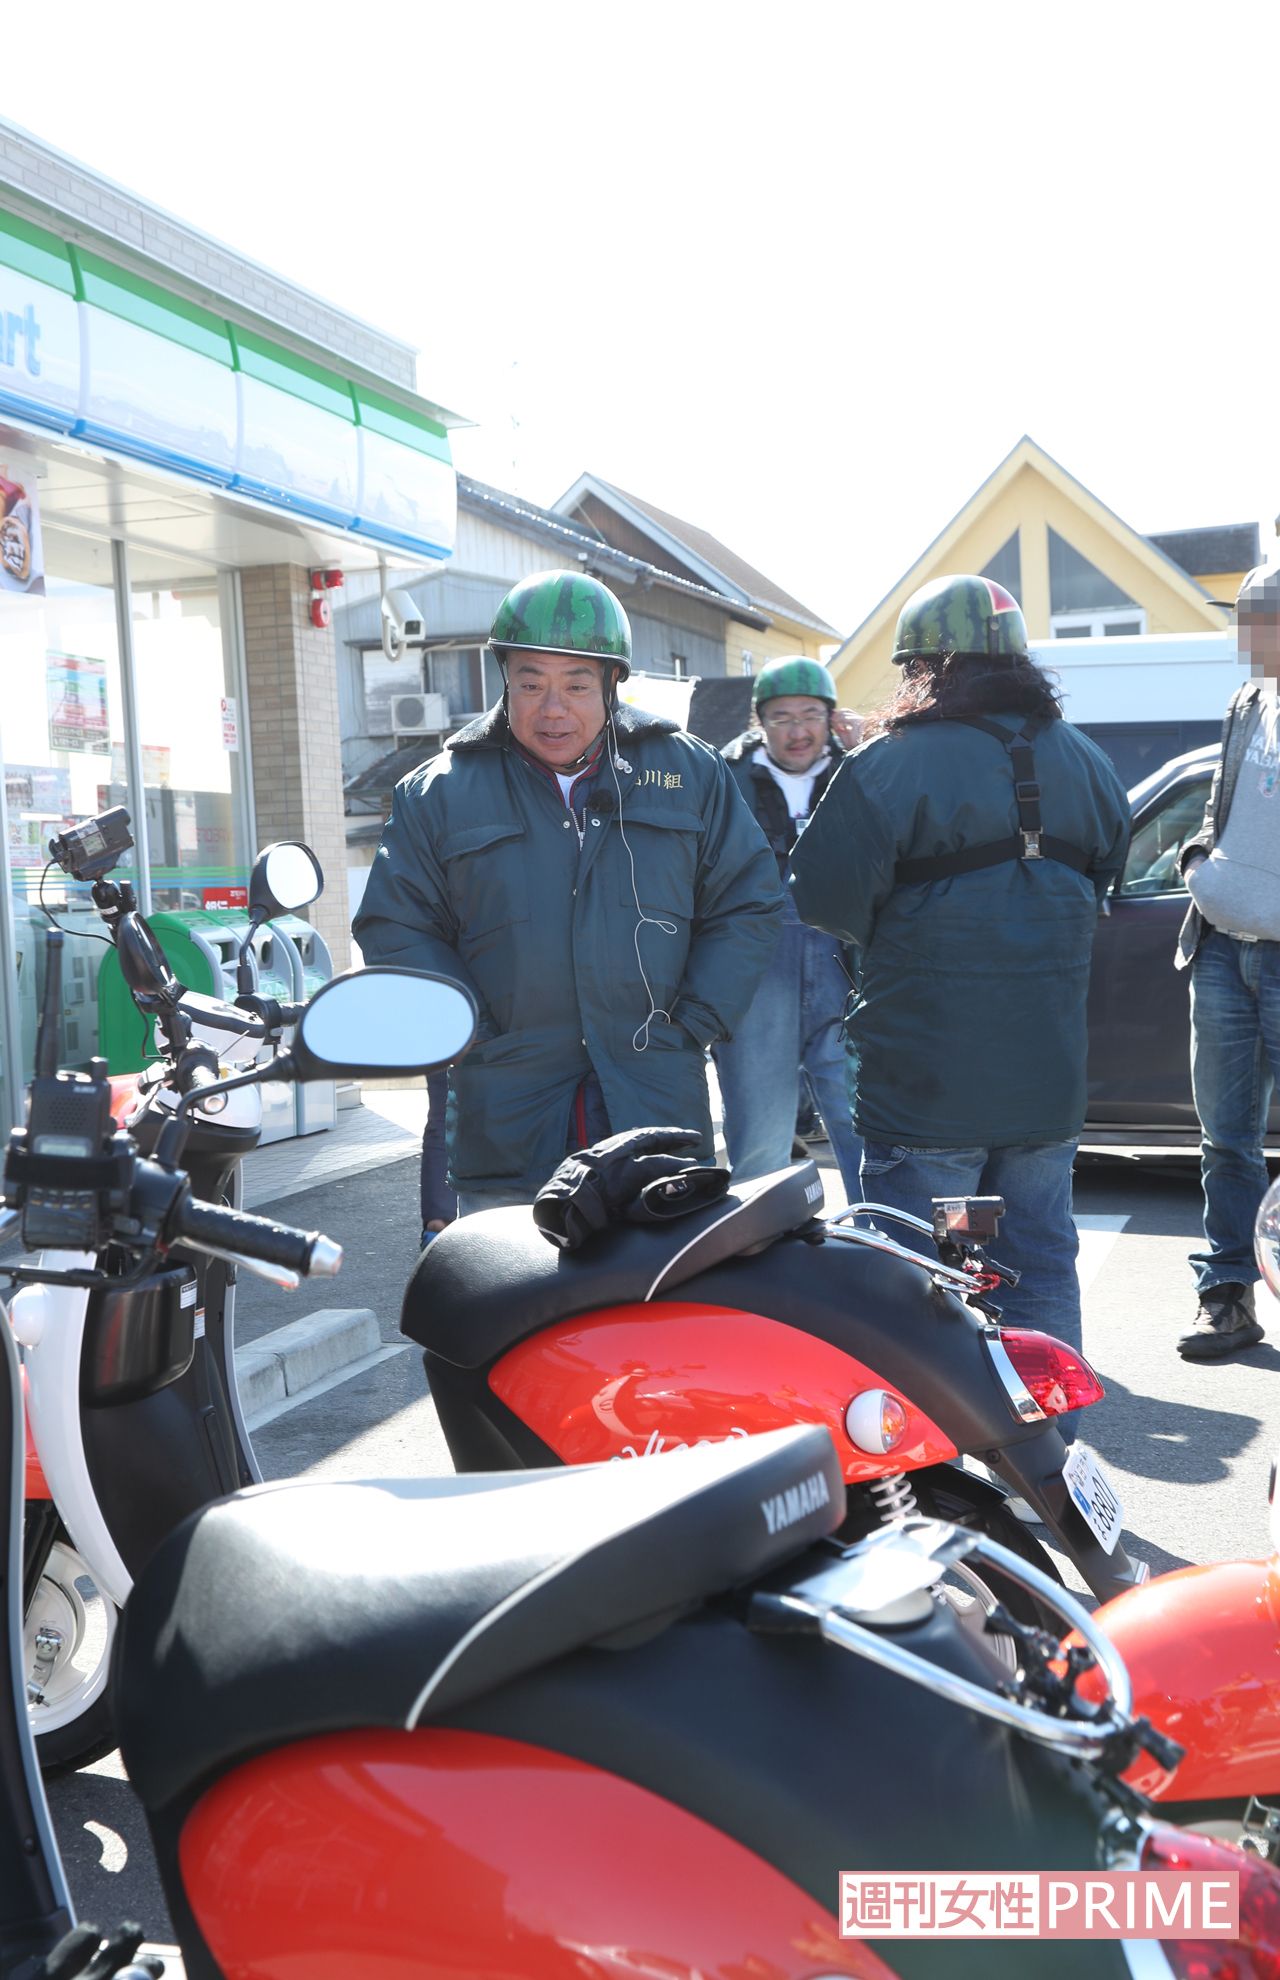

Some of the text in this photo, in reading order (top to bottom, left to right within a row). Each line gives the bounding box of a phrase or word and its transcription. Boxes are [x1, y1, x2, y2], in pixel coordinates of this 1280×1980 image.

[0, 304, 41, 377] rt
[760, 1470, 831, 1536] YAMAHA
[1091, 1467, 1119, 1532] 8801
